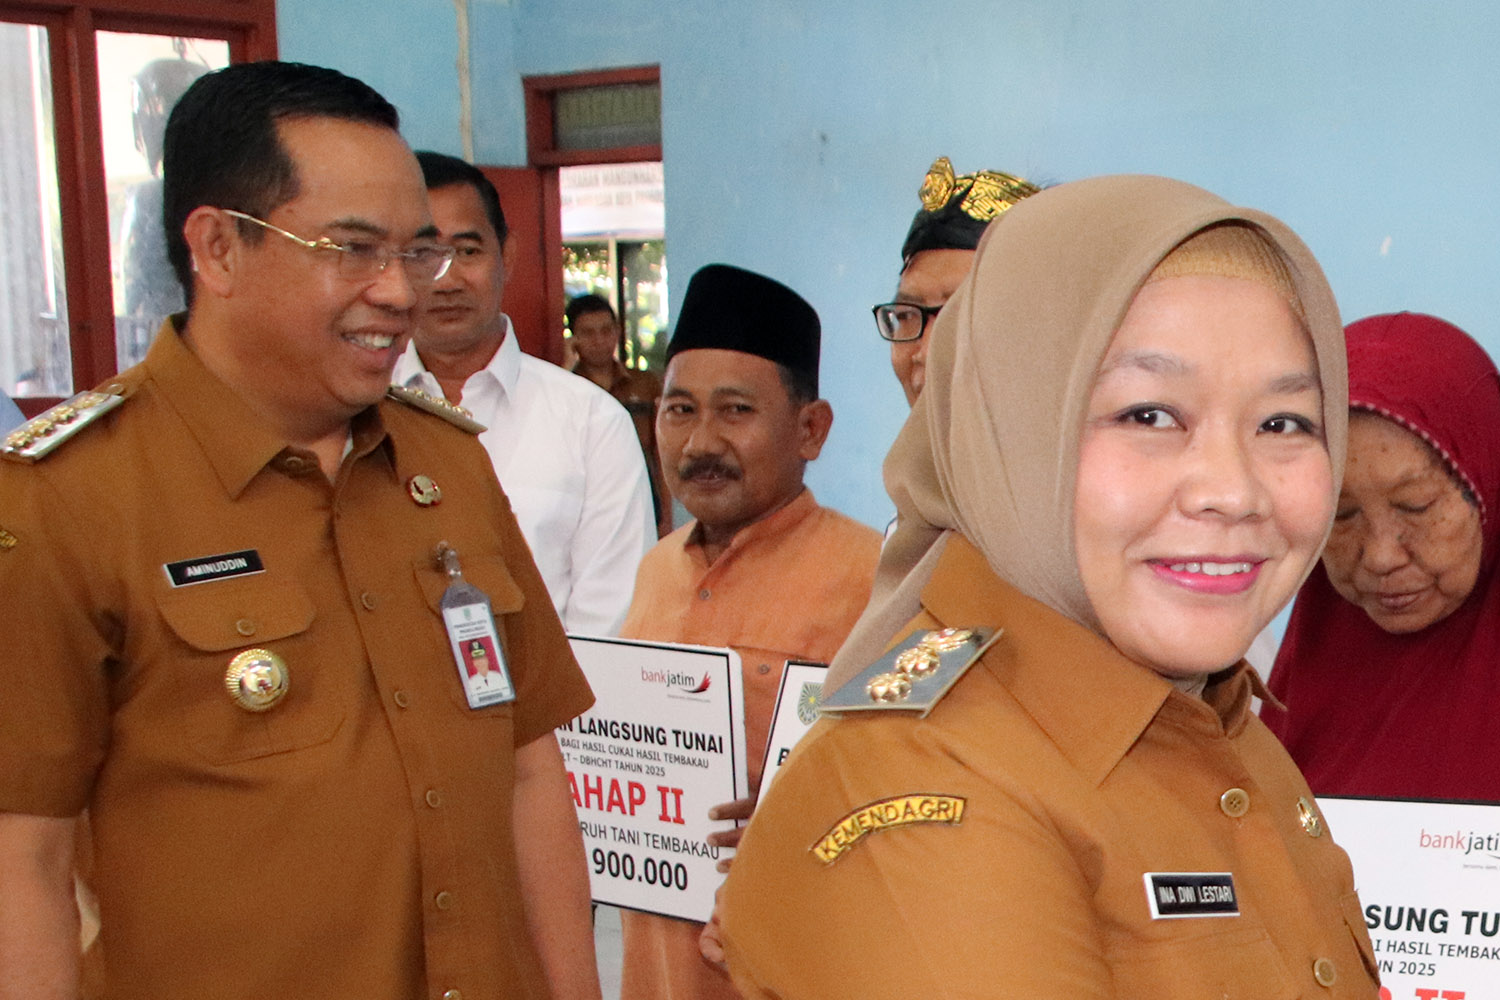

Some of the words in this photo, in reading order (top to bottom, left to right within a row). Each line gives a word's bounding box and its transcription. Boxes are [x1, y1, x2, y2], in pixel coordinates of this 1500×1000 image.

[186, 557, 248, 577] AMINUDDIN
[641, 666, 695, 687] bankjatim
[578, 716, 667, 746] LANGSUNG
[672, 730, 724, 754] TUNAI
[561, 737, 580, 749] BAGI
[582, 740, 607, 754] HASIL
[608, 745, 634, 757] CUKAI
[636, 748, 661, 762] HASIL
[664, 753, 709, 769] TEMBAKAU
[580, 755, 613, 768] DBHCHT
[615, 762, 642, 774] TAHUN
[645, 765, 666, 777] 2025
[657, 785, 686, 825] II
[581, 821, 607, 839] RUH
[611, 826, 640, 846] TANI
[644, 832, 720, 860] TEMBAKAU
[818, 799, 959, 861] KEMENDAGRI
[592, 848, 688, 891] 900.000
[1158, 886, 1177, 904] INA
[1178, 886, 1196, 903] DWI
[1198, 886, 1233, 903] LESTARI
[1365, 904, 1449, 934] SUNG
[1386, 940, 1432, 956] HASIL
[1398, 961, 1436, 976] 2025
